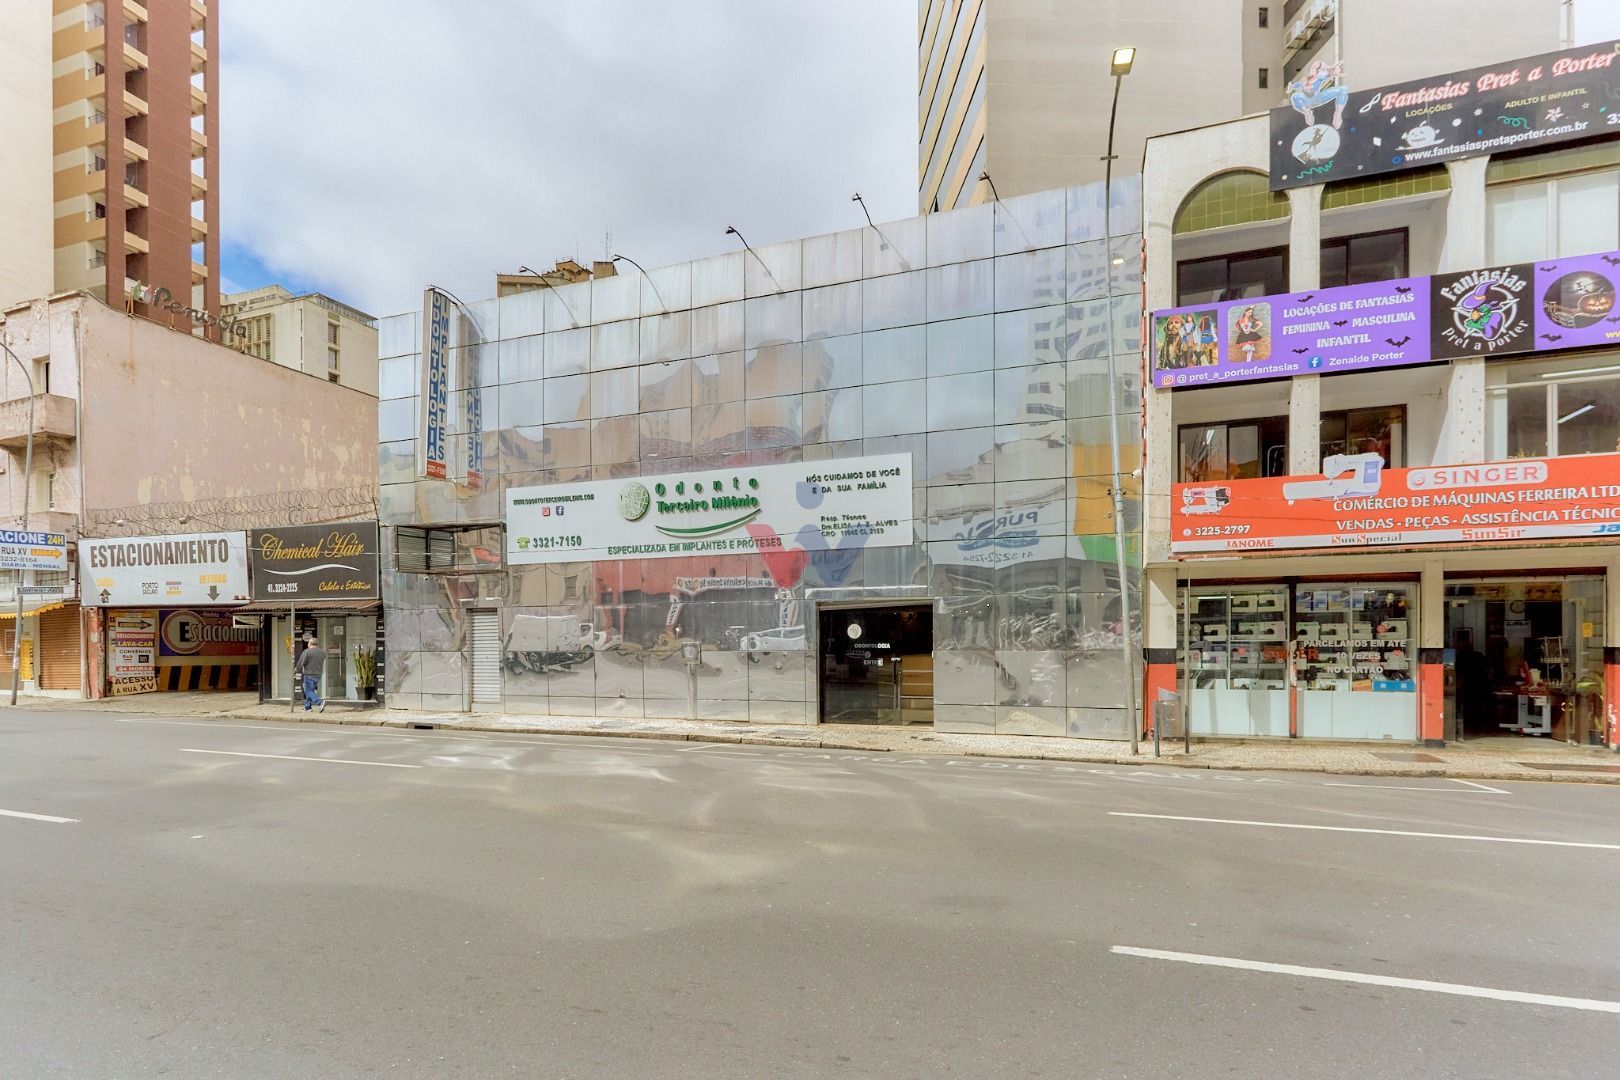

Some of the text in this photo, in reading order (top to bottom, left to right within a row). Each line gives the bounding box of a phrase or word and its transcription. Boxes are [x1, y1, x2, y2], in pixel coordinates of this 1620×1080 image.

[1381, 52, 1617, 111] Fantasias Pret a Porter
[1405, 87, 1588, 118] LOCAÇÕES ADULTO E INFANTIL
[1405, 121, 1590, 161] www.fantasiaspretaporter.com.br
[1440, 266, 1528, 302] Fantasias
[1283, 293, 1415, 319] LOCAÇÕES DE FANTASIAS
[1283, 312, 1416, 336] FEMININA MASCULINA
[1317, 333, 1371, 348] INFANTIL
[1329, 351, 1405, 367] Zenaide Porter
[427, 291, 441, 460] ODONTOLOGIA
[437, 296, 449, 461] IMPLANTES
[806, 467, 901, 483] NÓS CUIDAMOS DE VOCÊ
[1433, 466, 1539, 485] SINGER
[655, 477, 760, 496] Odonto
[821, 486, 832, 494] DA
[837, 484, 852, 492] SUA
[857, 480, 887, 490] FAMÍLIA
[656, 494, 760, 516] Terceiro Milênio
[1333, 496, 1409, 512] COMÉRCIO
[1412, 496, 1430, 508] DE
[1433, 491, 1515, 509] MÁQUINAS
[1518, 486, 1589, 502] FERREIRA
[1336, 518, 1394, 531] VENDAS
[1405, 514, 1450, 528] PEÇAS
[1461, 509, 1559, 525] ASSISTÊNCIA
[47, 535, 64, 545] 24H
[1195, 525, 1250, 536] 3225-2797
[1, 546, 16, 555] RUA
[17, 547, 28, 556] XV
[260, 531, 365, 561] Chemical Hair
[533, 535, 582, 549] 3321-7150
[608, 536, 783, 557] ESPECIALIZADA EM IMPLANTES E PRÓTESES
[1227, 538, 1274, 549] JANOME
[90, 538, 229, 568] ESTACIONAMENTO
[1303, 639, 1368, 648] PARCELAMOS
[1371, 639, 1385, 648] EM
[1336, 651, 1381, 660] 10 VEZES
[1327, 666, 1345, 674] NO
[116, 676, 154, 685] ACESSO
[139, 682, 154, 691] XV
